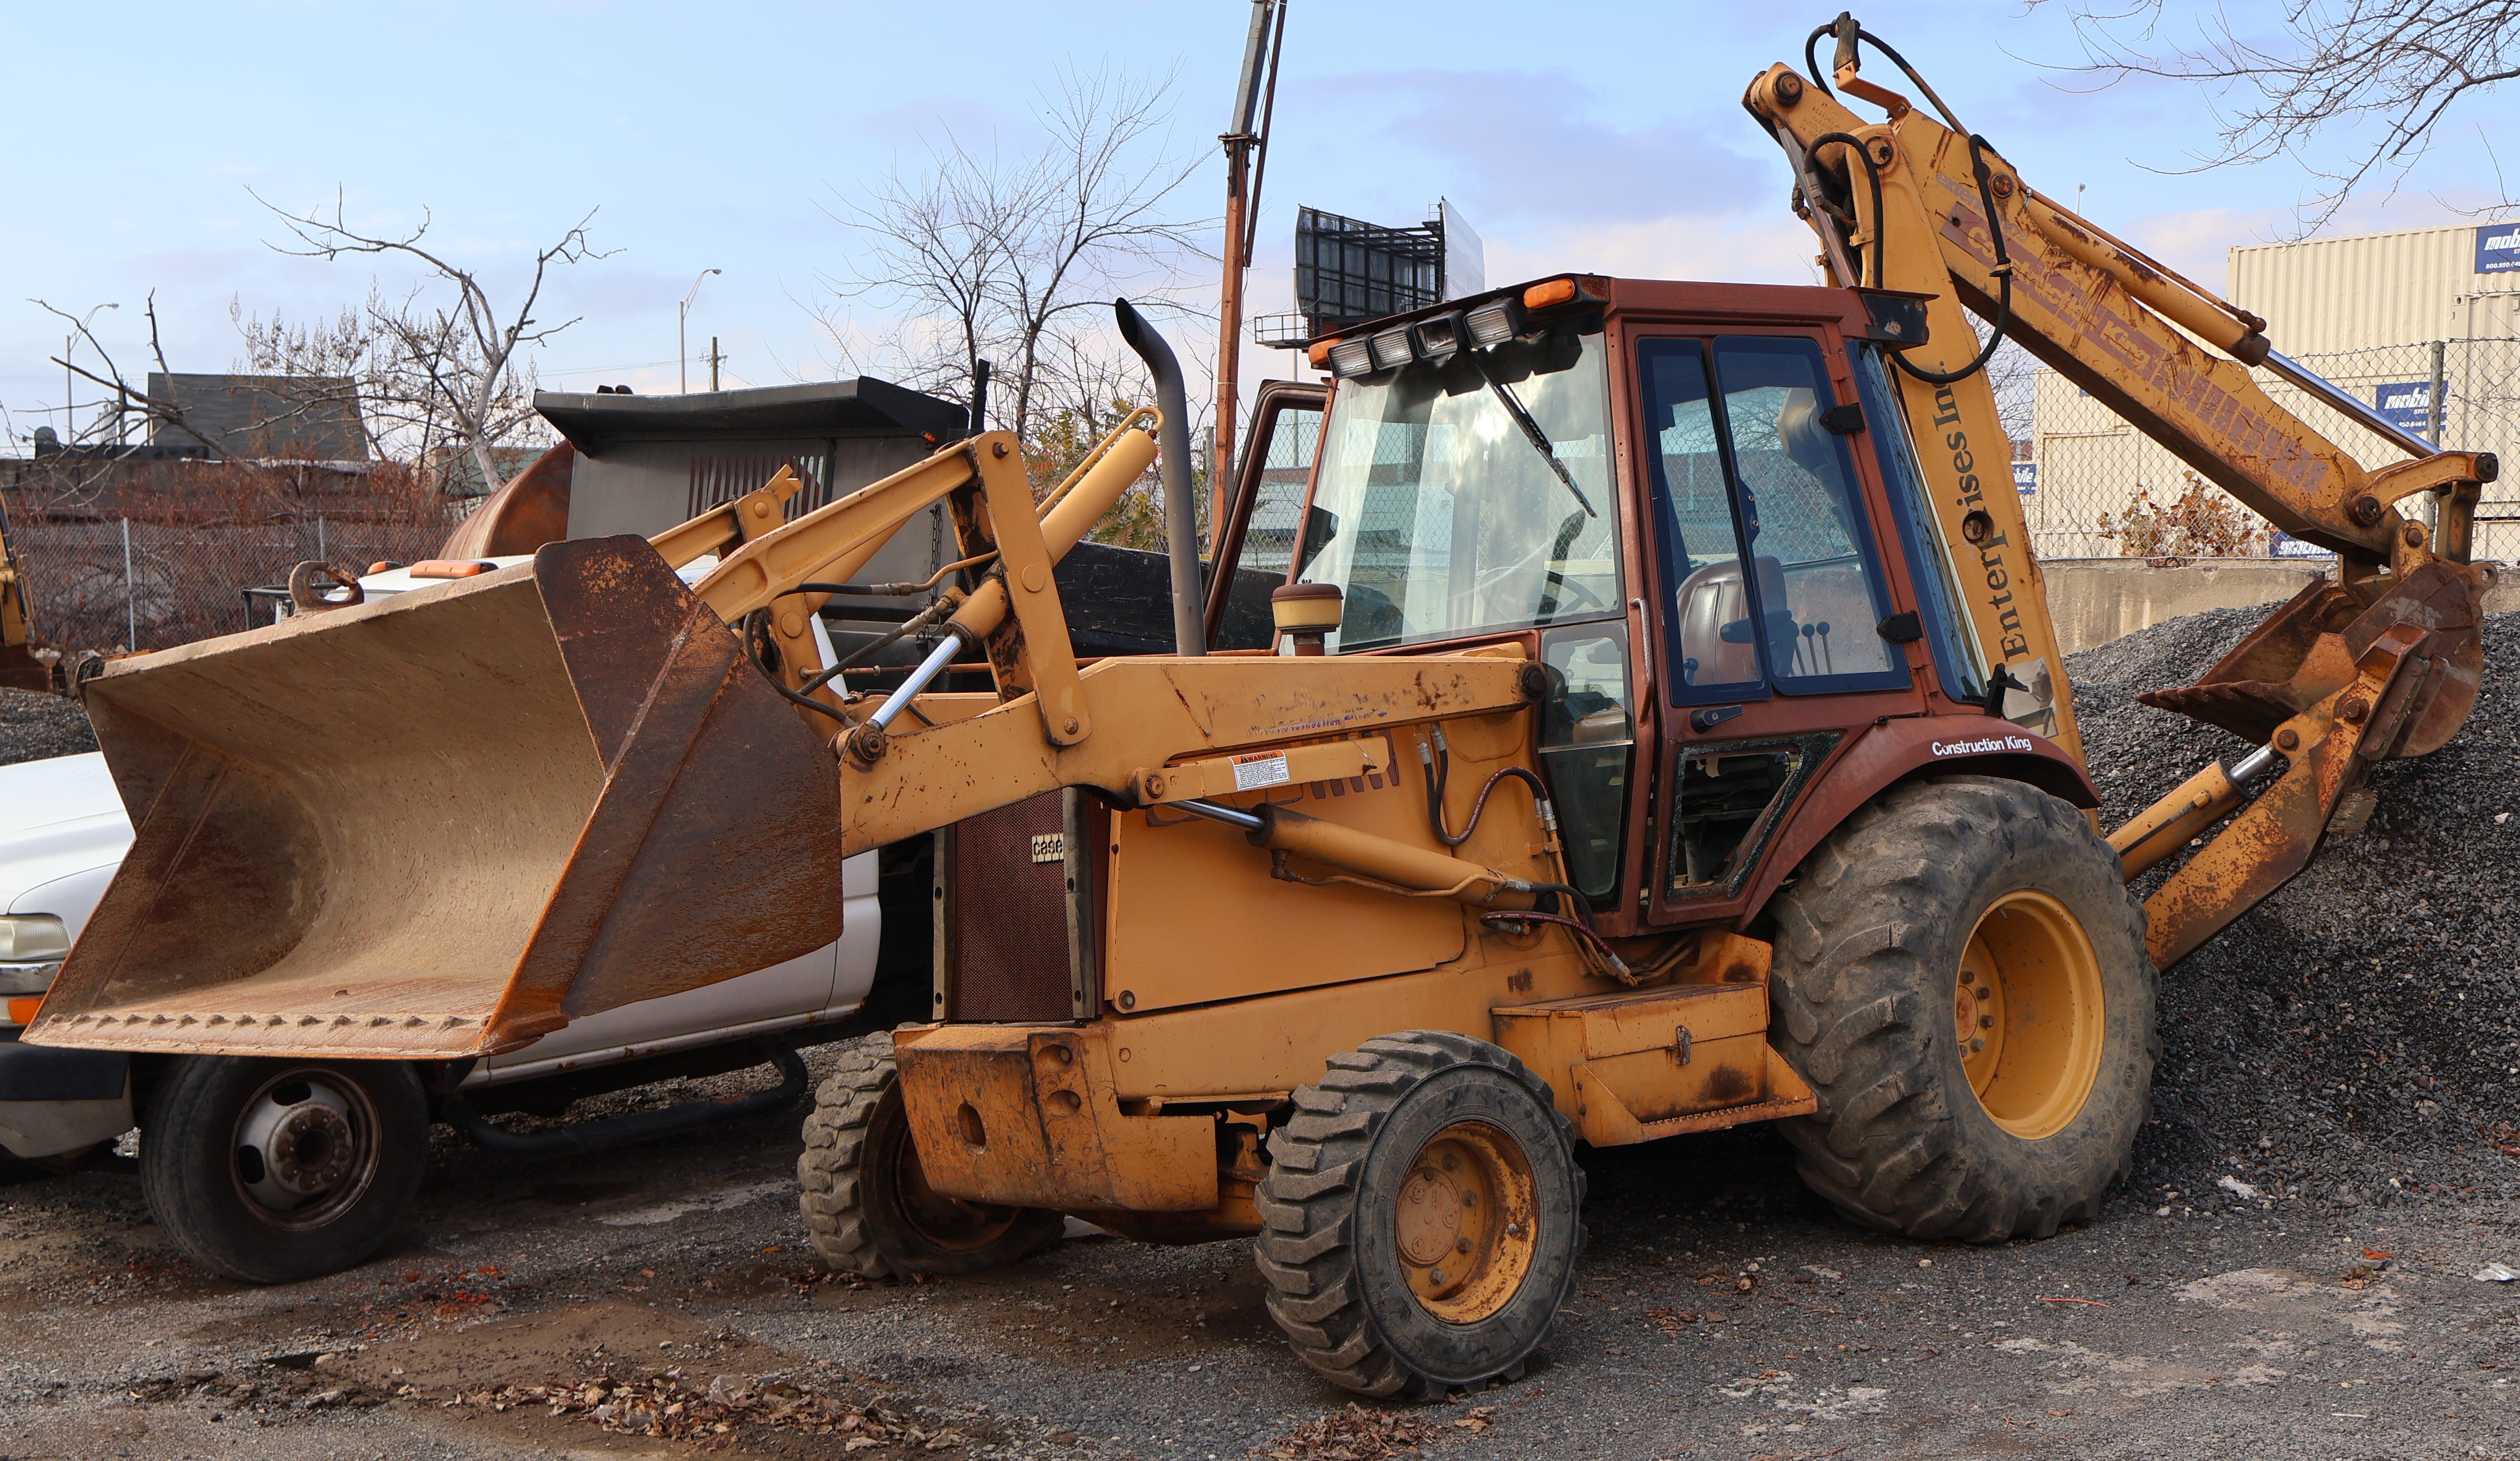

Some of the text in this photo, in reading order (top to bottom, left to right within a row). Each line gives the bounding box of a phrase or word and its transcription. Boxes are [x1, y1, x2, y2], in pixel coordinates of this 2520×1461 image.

[2484, 228, 2520, 250] mob
[2100, 319, 2151, 365] King
[1932, 735, 2033, 756] Construction King
[1247, 753, 1277, 763] WARNING
[1034, 840, 1063, 856] case
